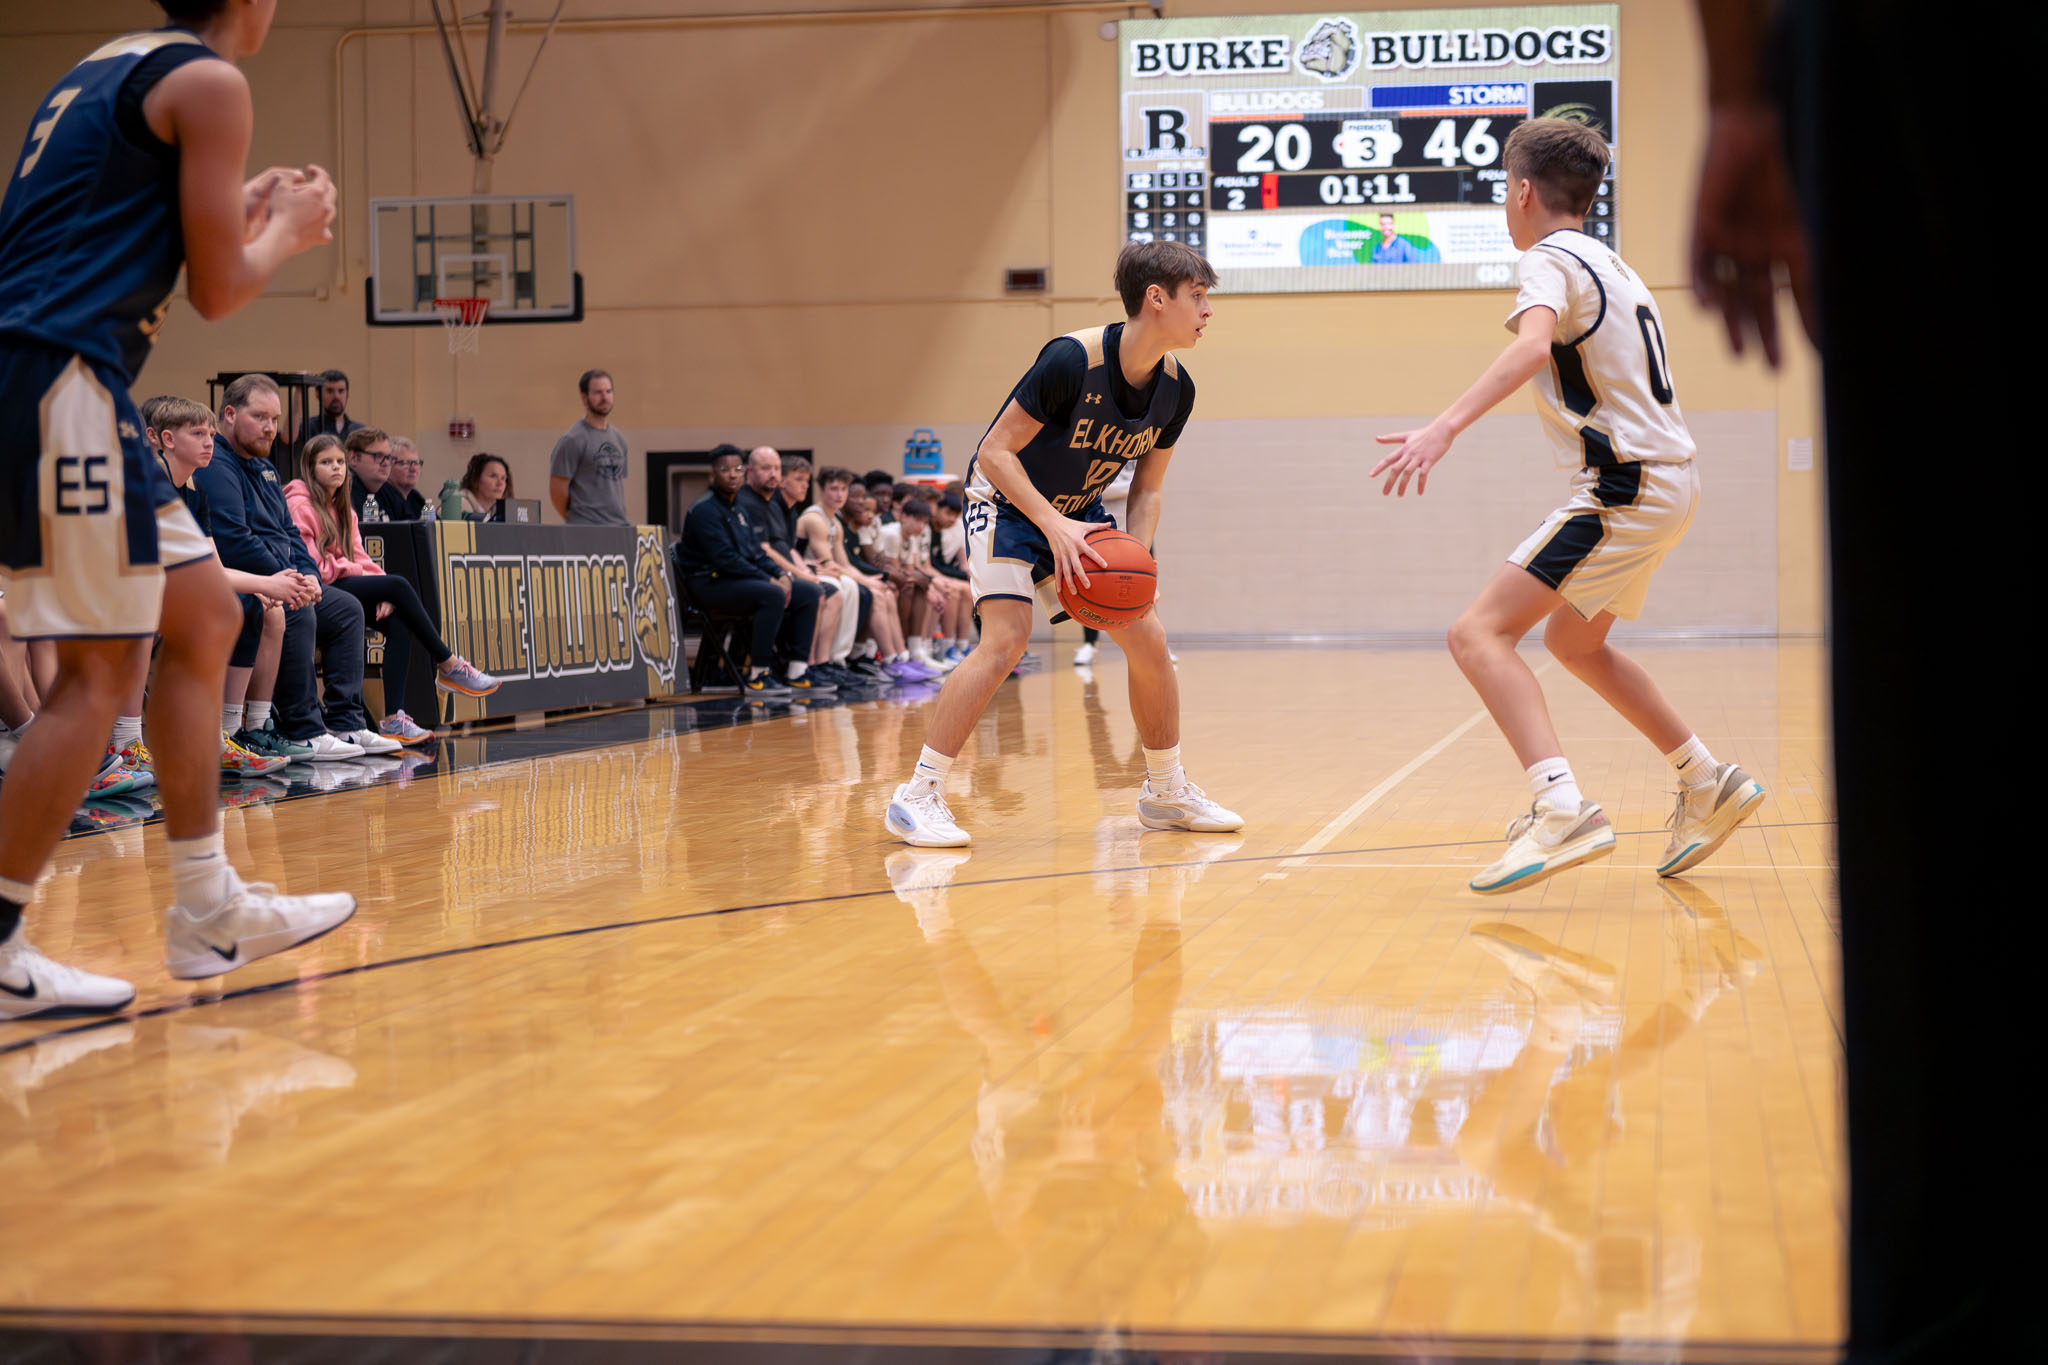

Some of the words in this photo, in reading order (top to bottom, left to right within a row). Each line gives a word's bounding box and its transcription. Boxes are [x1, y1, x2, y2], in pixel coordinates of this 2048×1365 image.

[1137, 40, 1284, 71] BURKE
[1371, 29, 1606, 65] BULLDOGS
[1210, 91, 1325, 111] BULLDOGS
[1449, 85, 1525, 105] STORM
[20, 87, 82, 178] 3
[1237, 124, 1312, 172] 20
[1360, 137, 1376, 161] 3
[1423, 118, 1499, 167] 46
[1134, 193, 1149, 208] 4
[1227, 189, 1246, 210] 2
[1319, 174, 1416, 205] 01:11
[1134, 212, 1149, 229] 5
[1636, 305, 1673, 406] 0
[1069, 418, 1162, 459] ELKHORN
[55, 455, 110, 516] ES
[451, 558, 529, 676] BURKE
[529, 556, 633, 674] BULLDOGS
